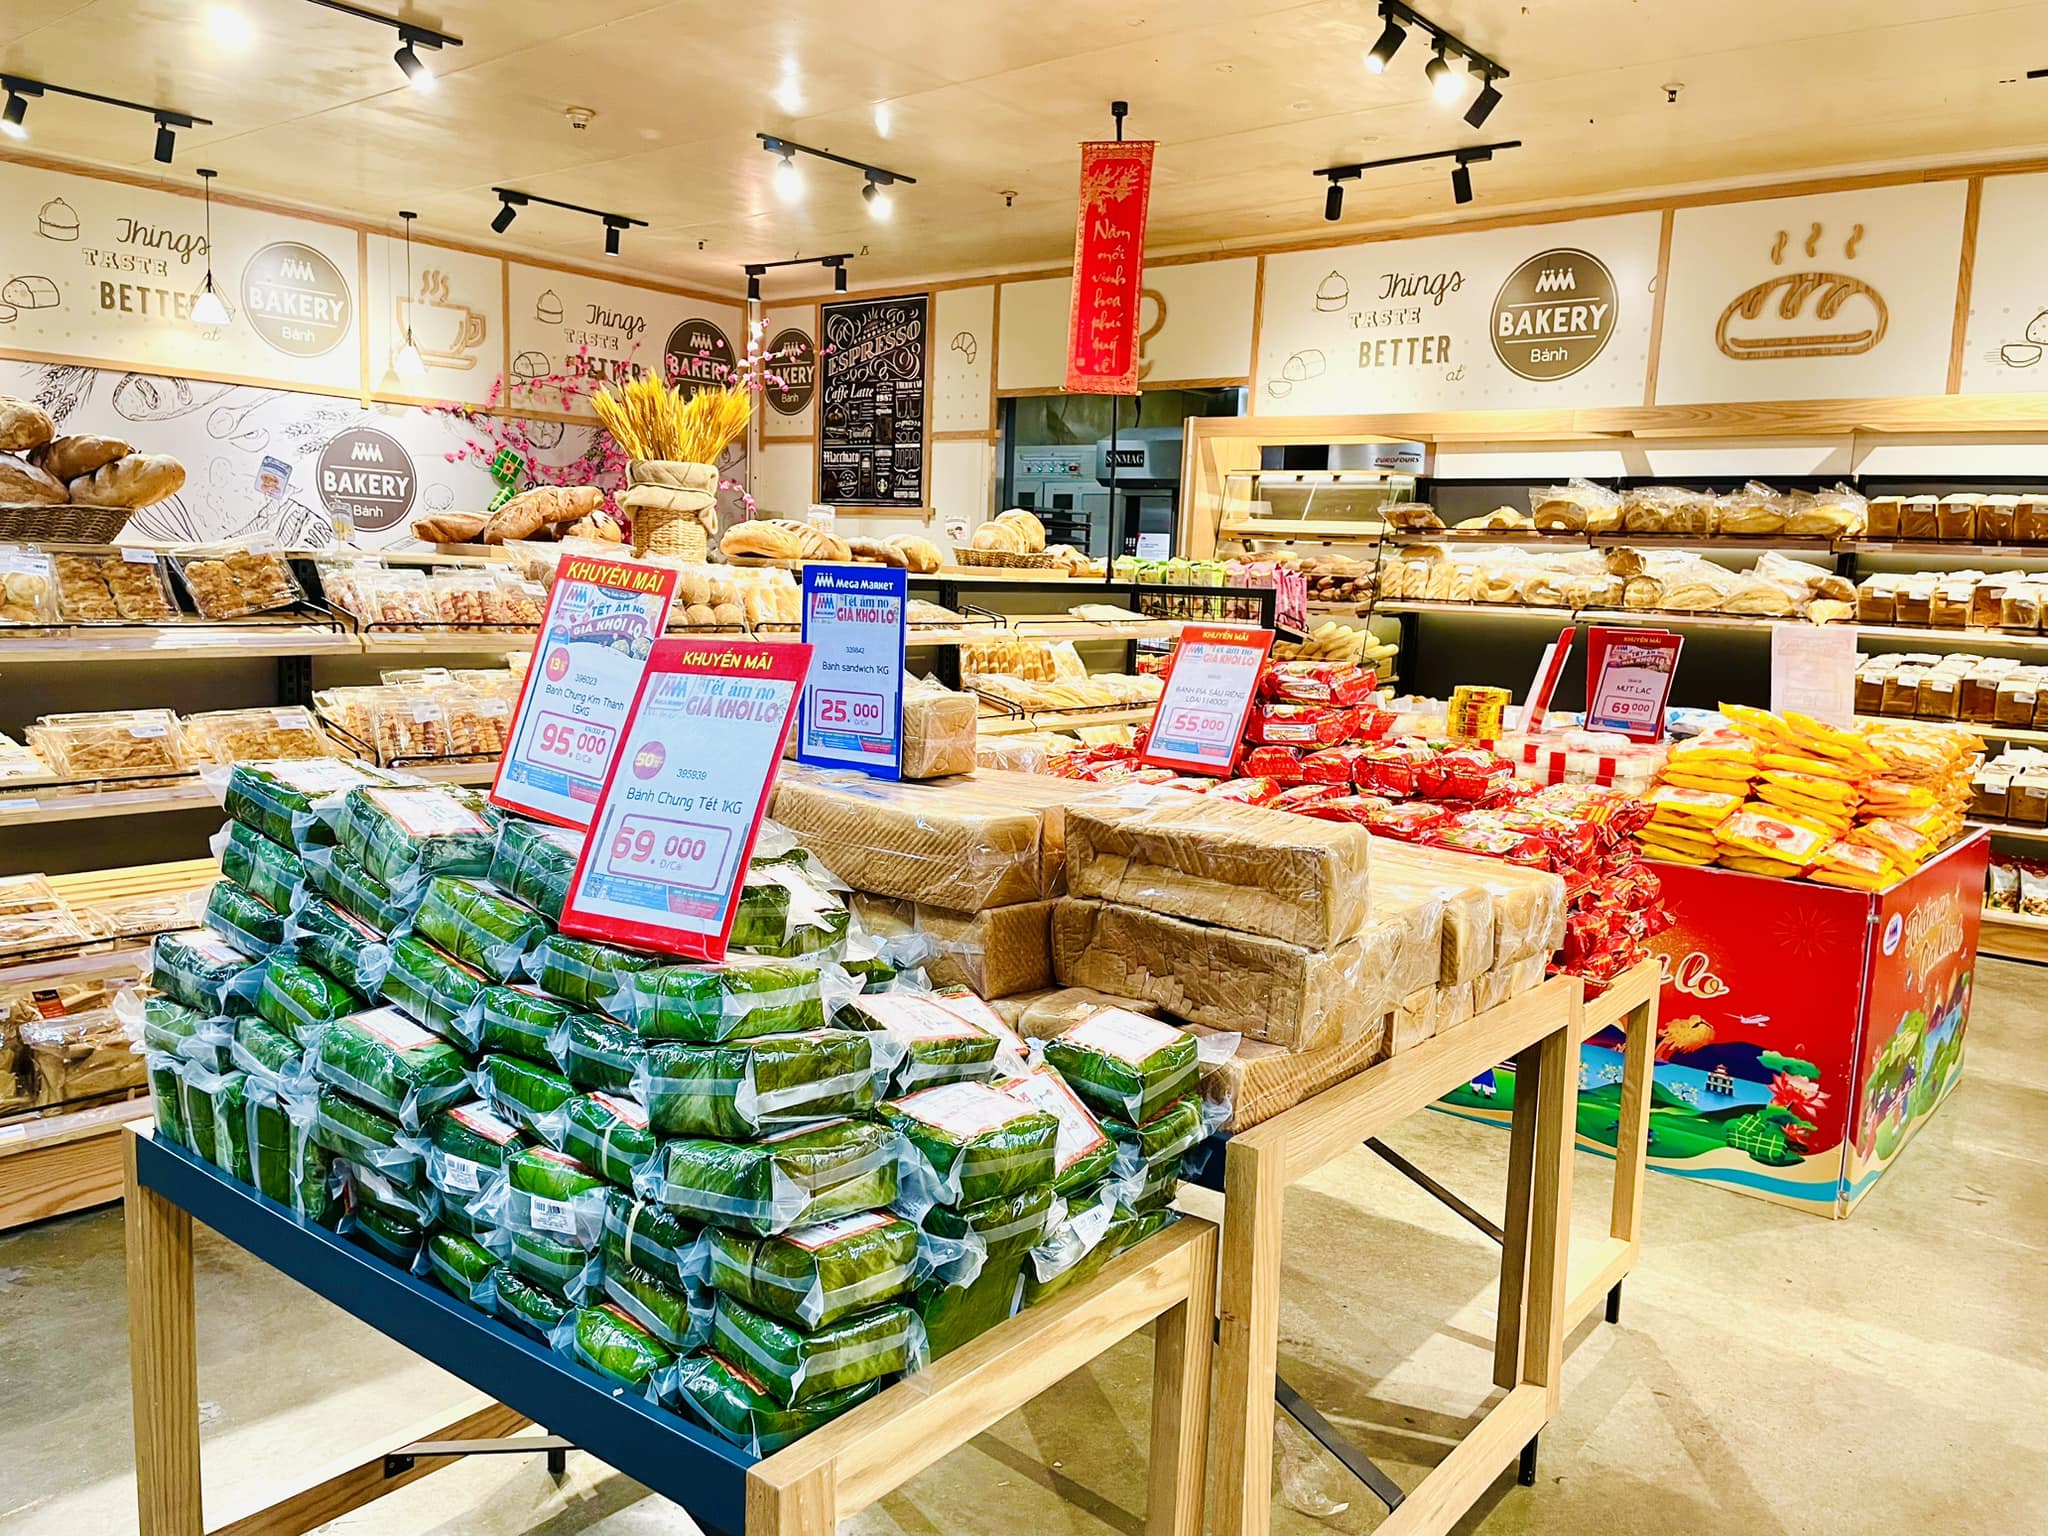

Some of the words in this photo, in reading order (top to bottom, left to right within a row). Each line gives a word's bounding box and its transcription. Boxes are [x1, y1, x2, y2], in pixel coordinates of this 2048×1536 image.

[117, 218, 211, 264] Things
[82, 248, 168, 277] TASTE
[1378, 269, 1466, 306] Things
[250, 287, 345, 322] BAKERY
[586, 304, 647, 339] Things
[1348, 306, 1422, 329] TASTE
[1499, 304, 1608, 337] BAKERY
[564, 328, 619, 350] TASTE
[827, 320, 921, 377] ESPRESSO
[1358, 335, 1452, 369] BETTER
[1530, 346, 1568, 363] Bánh
[766, 365, 816, 386] BAKERY
[1445, 364, 1465, 382] at
[850, 384, 874, 398] Latte
[895, 431, 921, 443] SOLO
[1106, 455, 1144, 465] SNMAG
[324, 470, 410, 497] BAKERY
[353, 504, 384, 518] Bánh
[632, 571, 665, 593] MÃI
[744, 652, 773, 671] MÃI
[756, 686, 776, 700] no
[722, 800, 743, 815] 1KG
